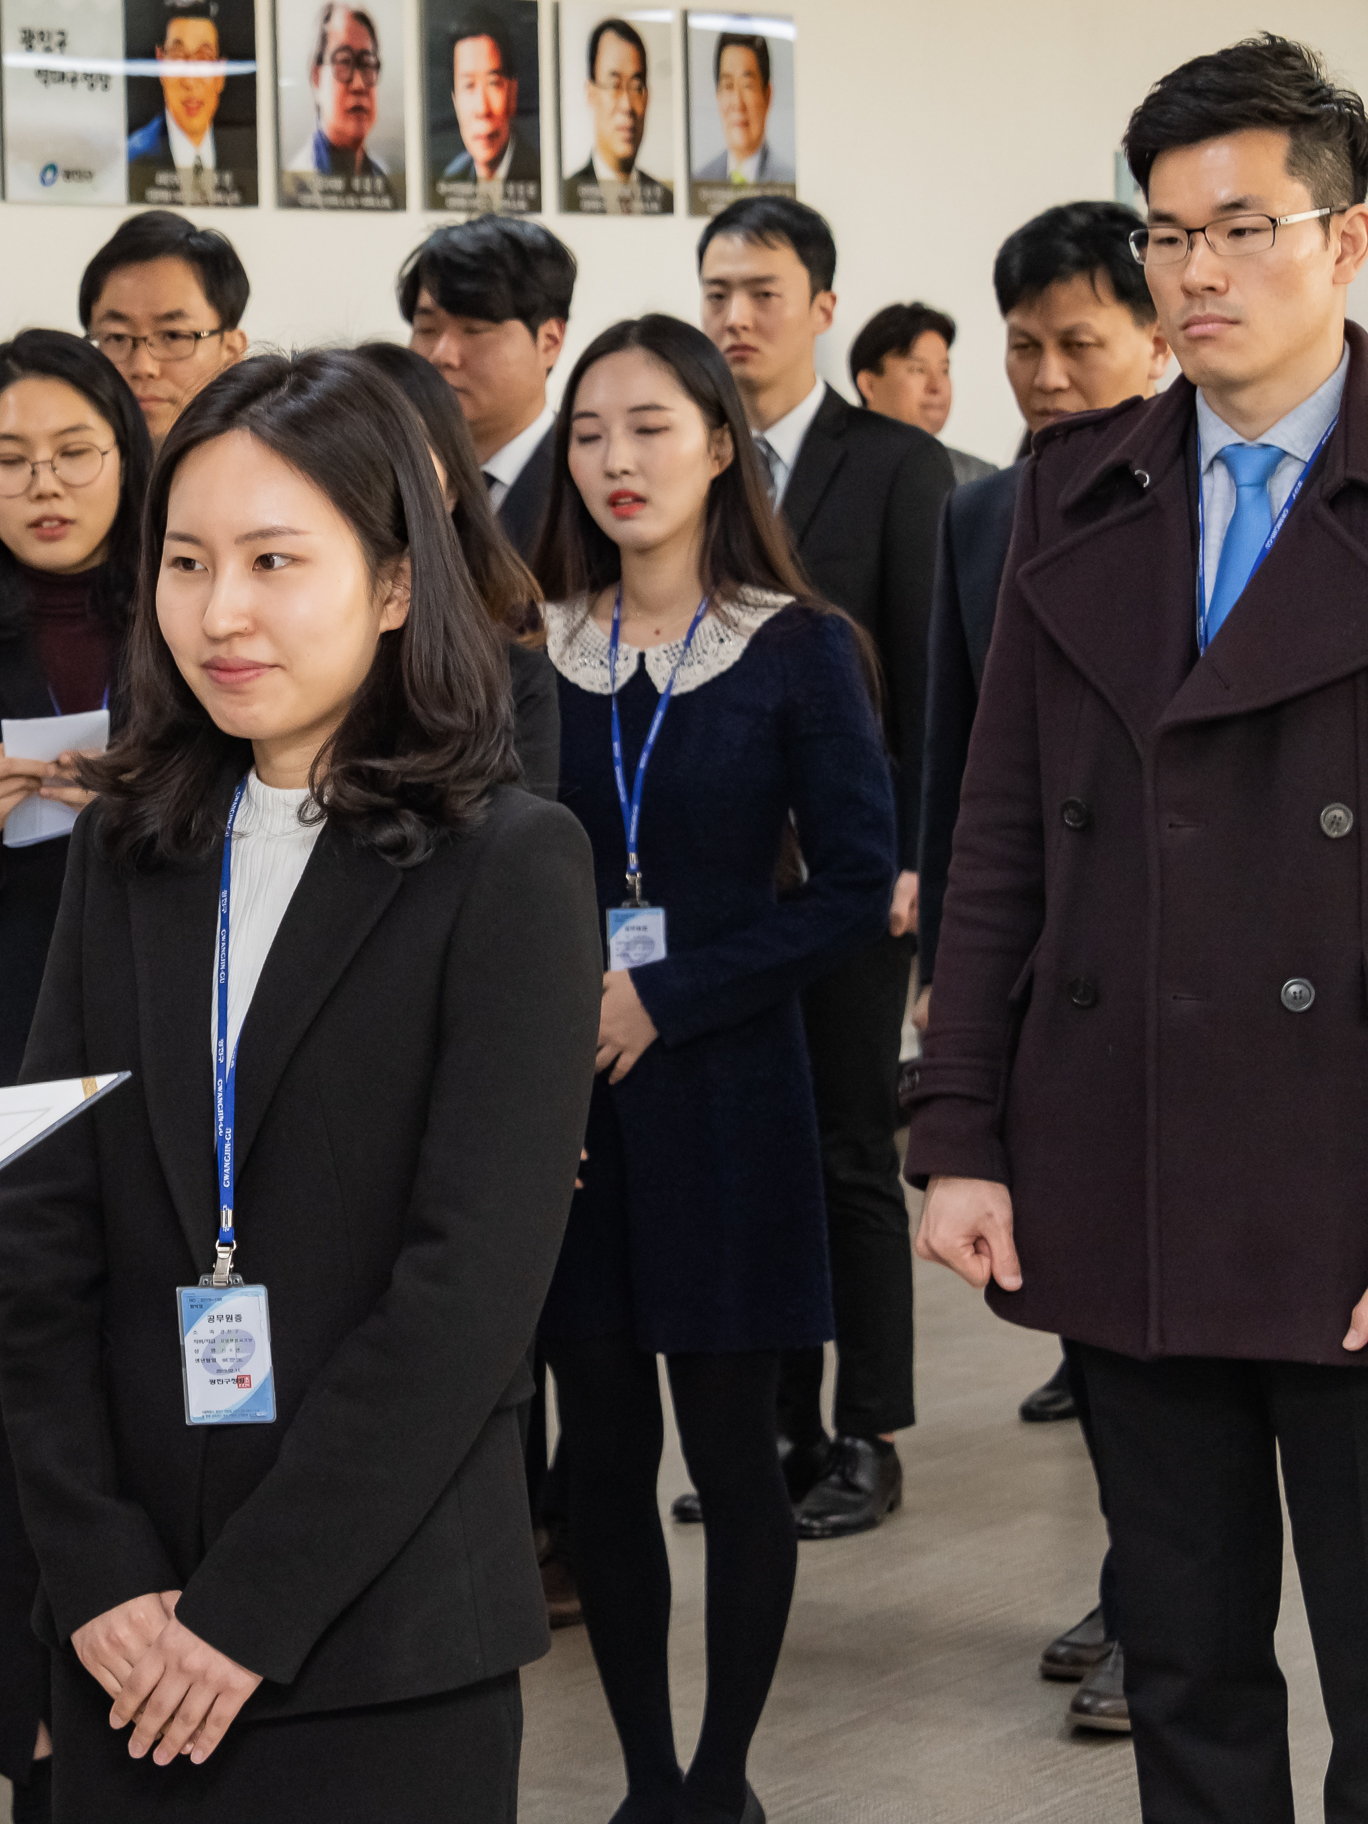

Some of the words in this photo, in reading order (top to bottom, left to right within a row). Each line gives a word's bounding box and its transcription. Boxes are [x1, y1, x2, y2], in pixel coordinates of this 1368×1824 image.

[218, 928, 227, 984] GWANGJIN-GU
[222, 1127, 232, 1188] GWANGJIN-GU
[207, 1314, 242, 1323] 공무원증
